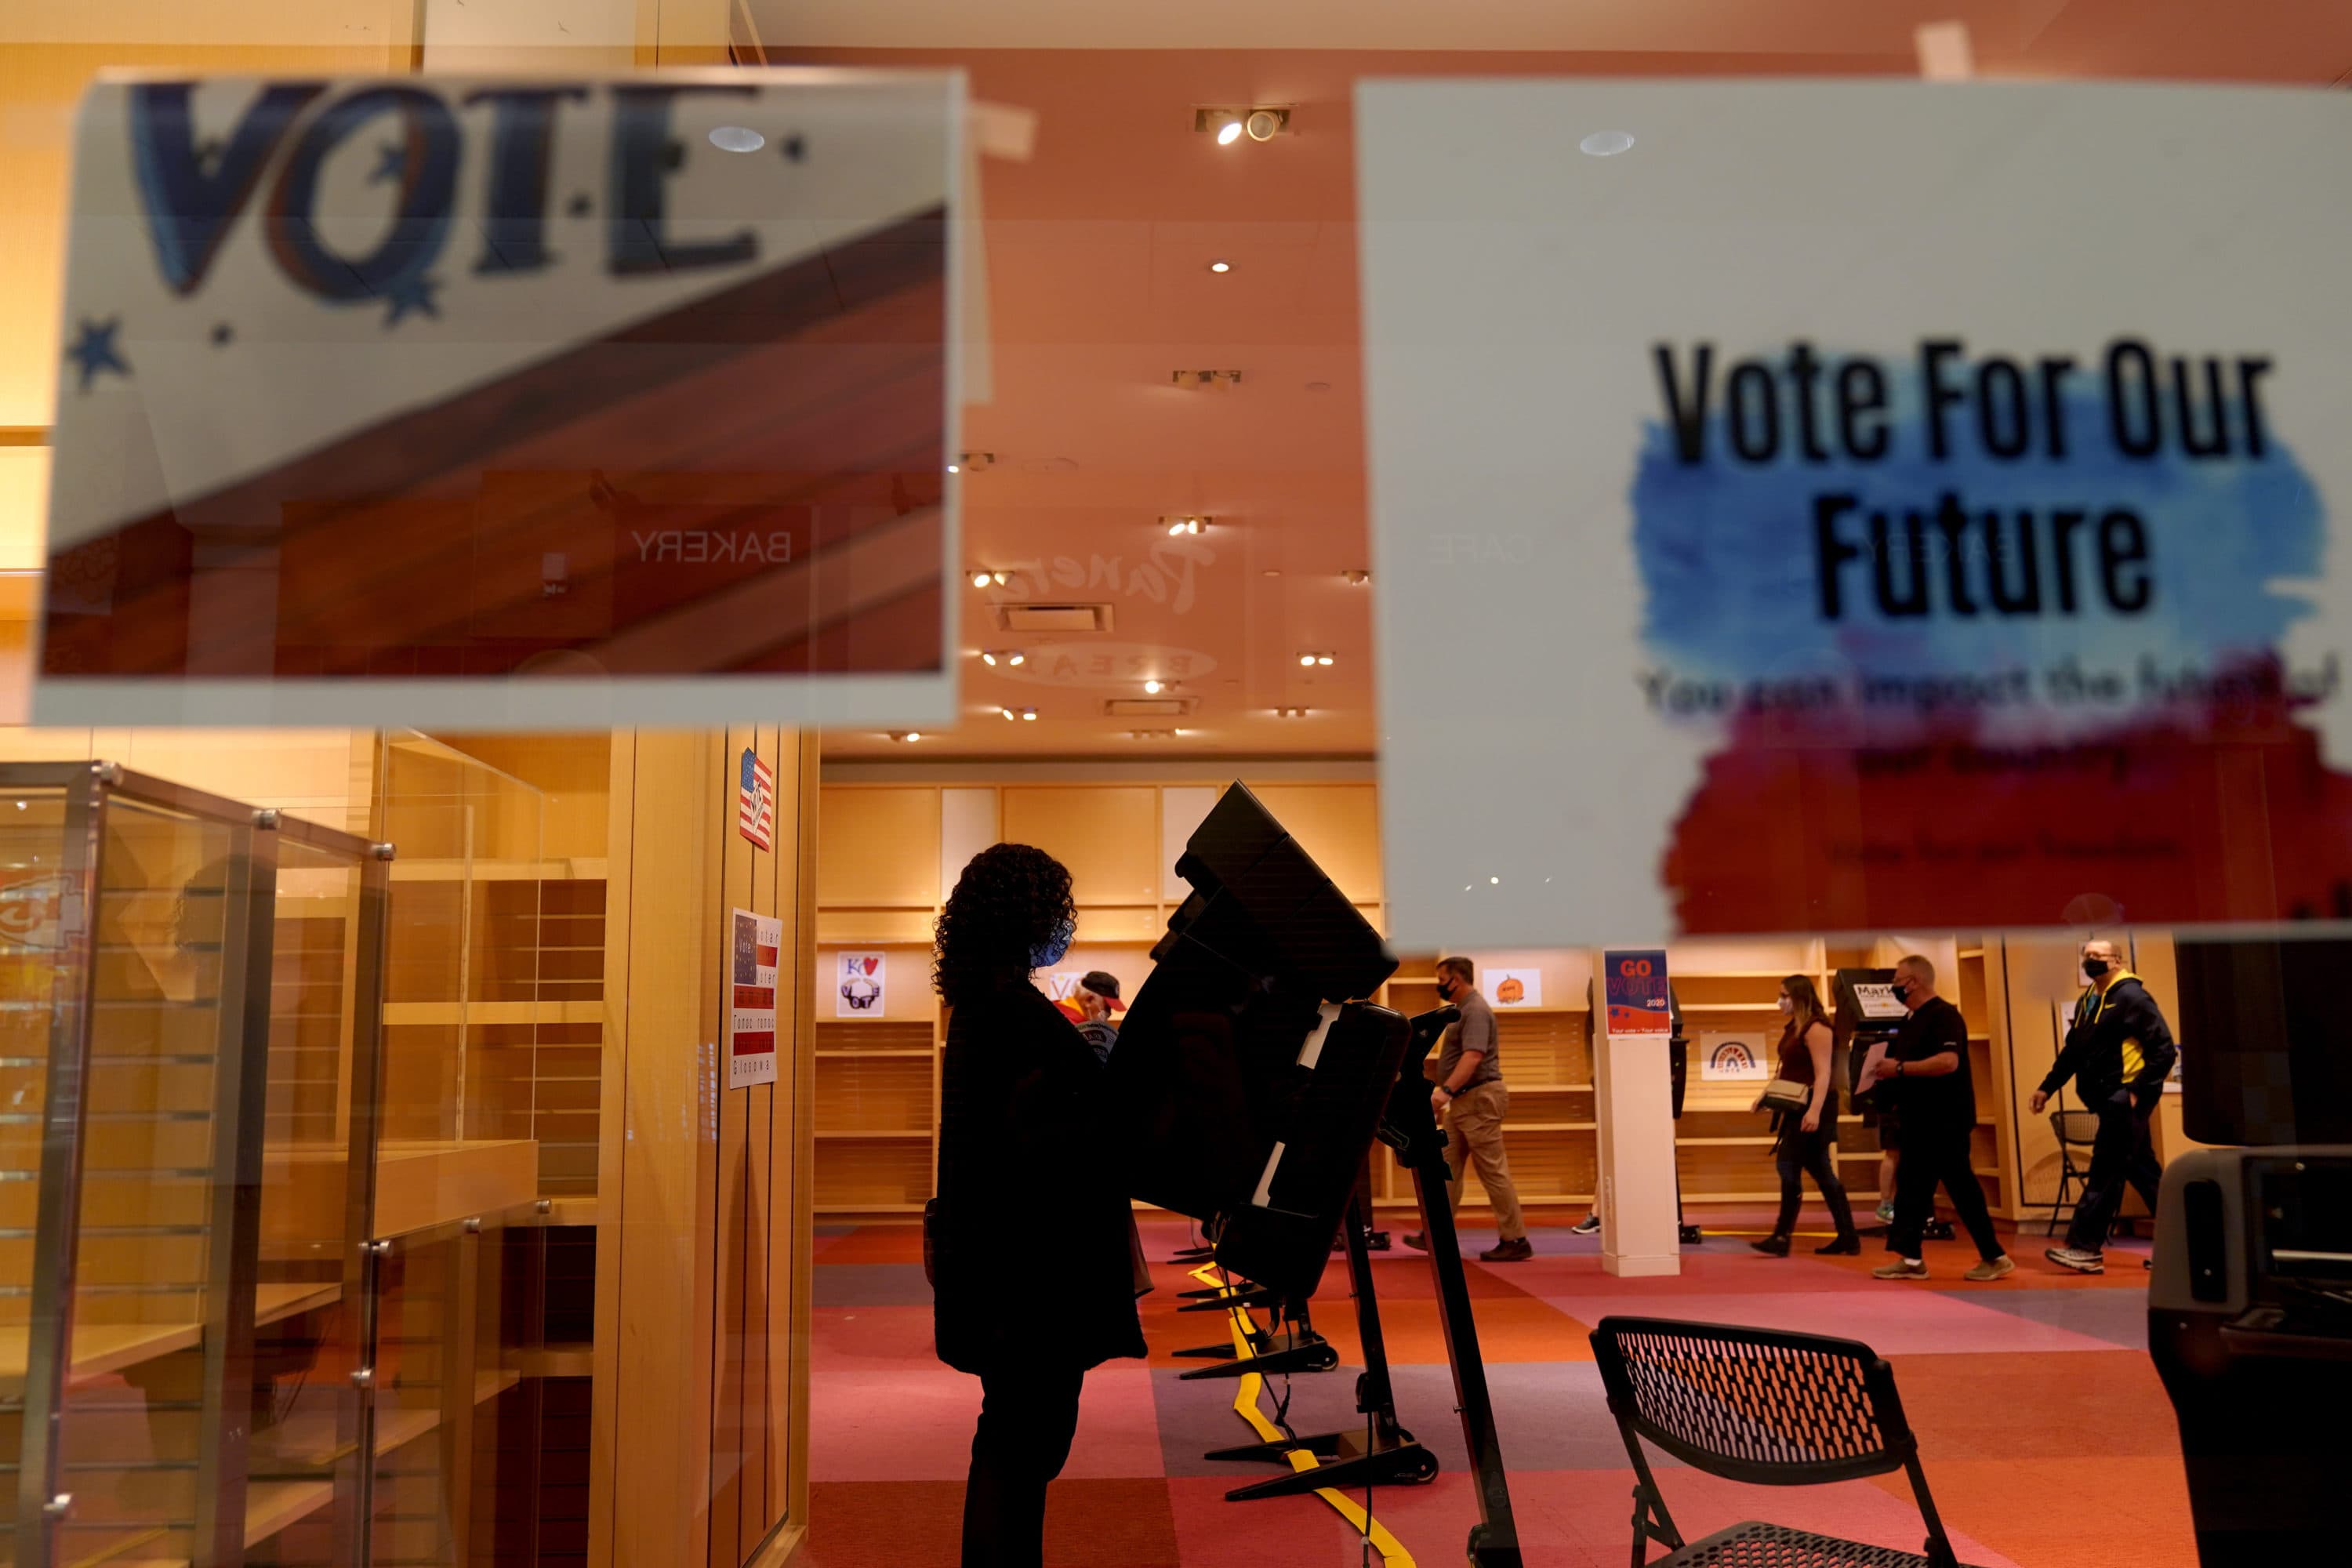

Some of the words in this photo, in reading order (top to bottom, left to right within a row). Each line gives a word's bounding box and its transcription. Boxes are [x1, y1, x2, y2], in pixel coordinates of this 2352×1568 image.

[128, 84, 759, 304] VOTE
[1650, 337, 1893, 465] Vote
[1918, 336, 2076, 462] For
[2103, 335, 2277, 462] Our
[1812, 489, 2154, 620] Future
[2047, 659, 2125, 708] the
[739, 936, 752, 954] Vote
[1621, 960, 1651, 977] GO
[840, 985, 880, 1010] VOTE
[1606, 977, 1668, 996] VOTE
[1647, 998, 1665, 1007] 2020
